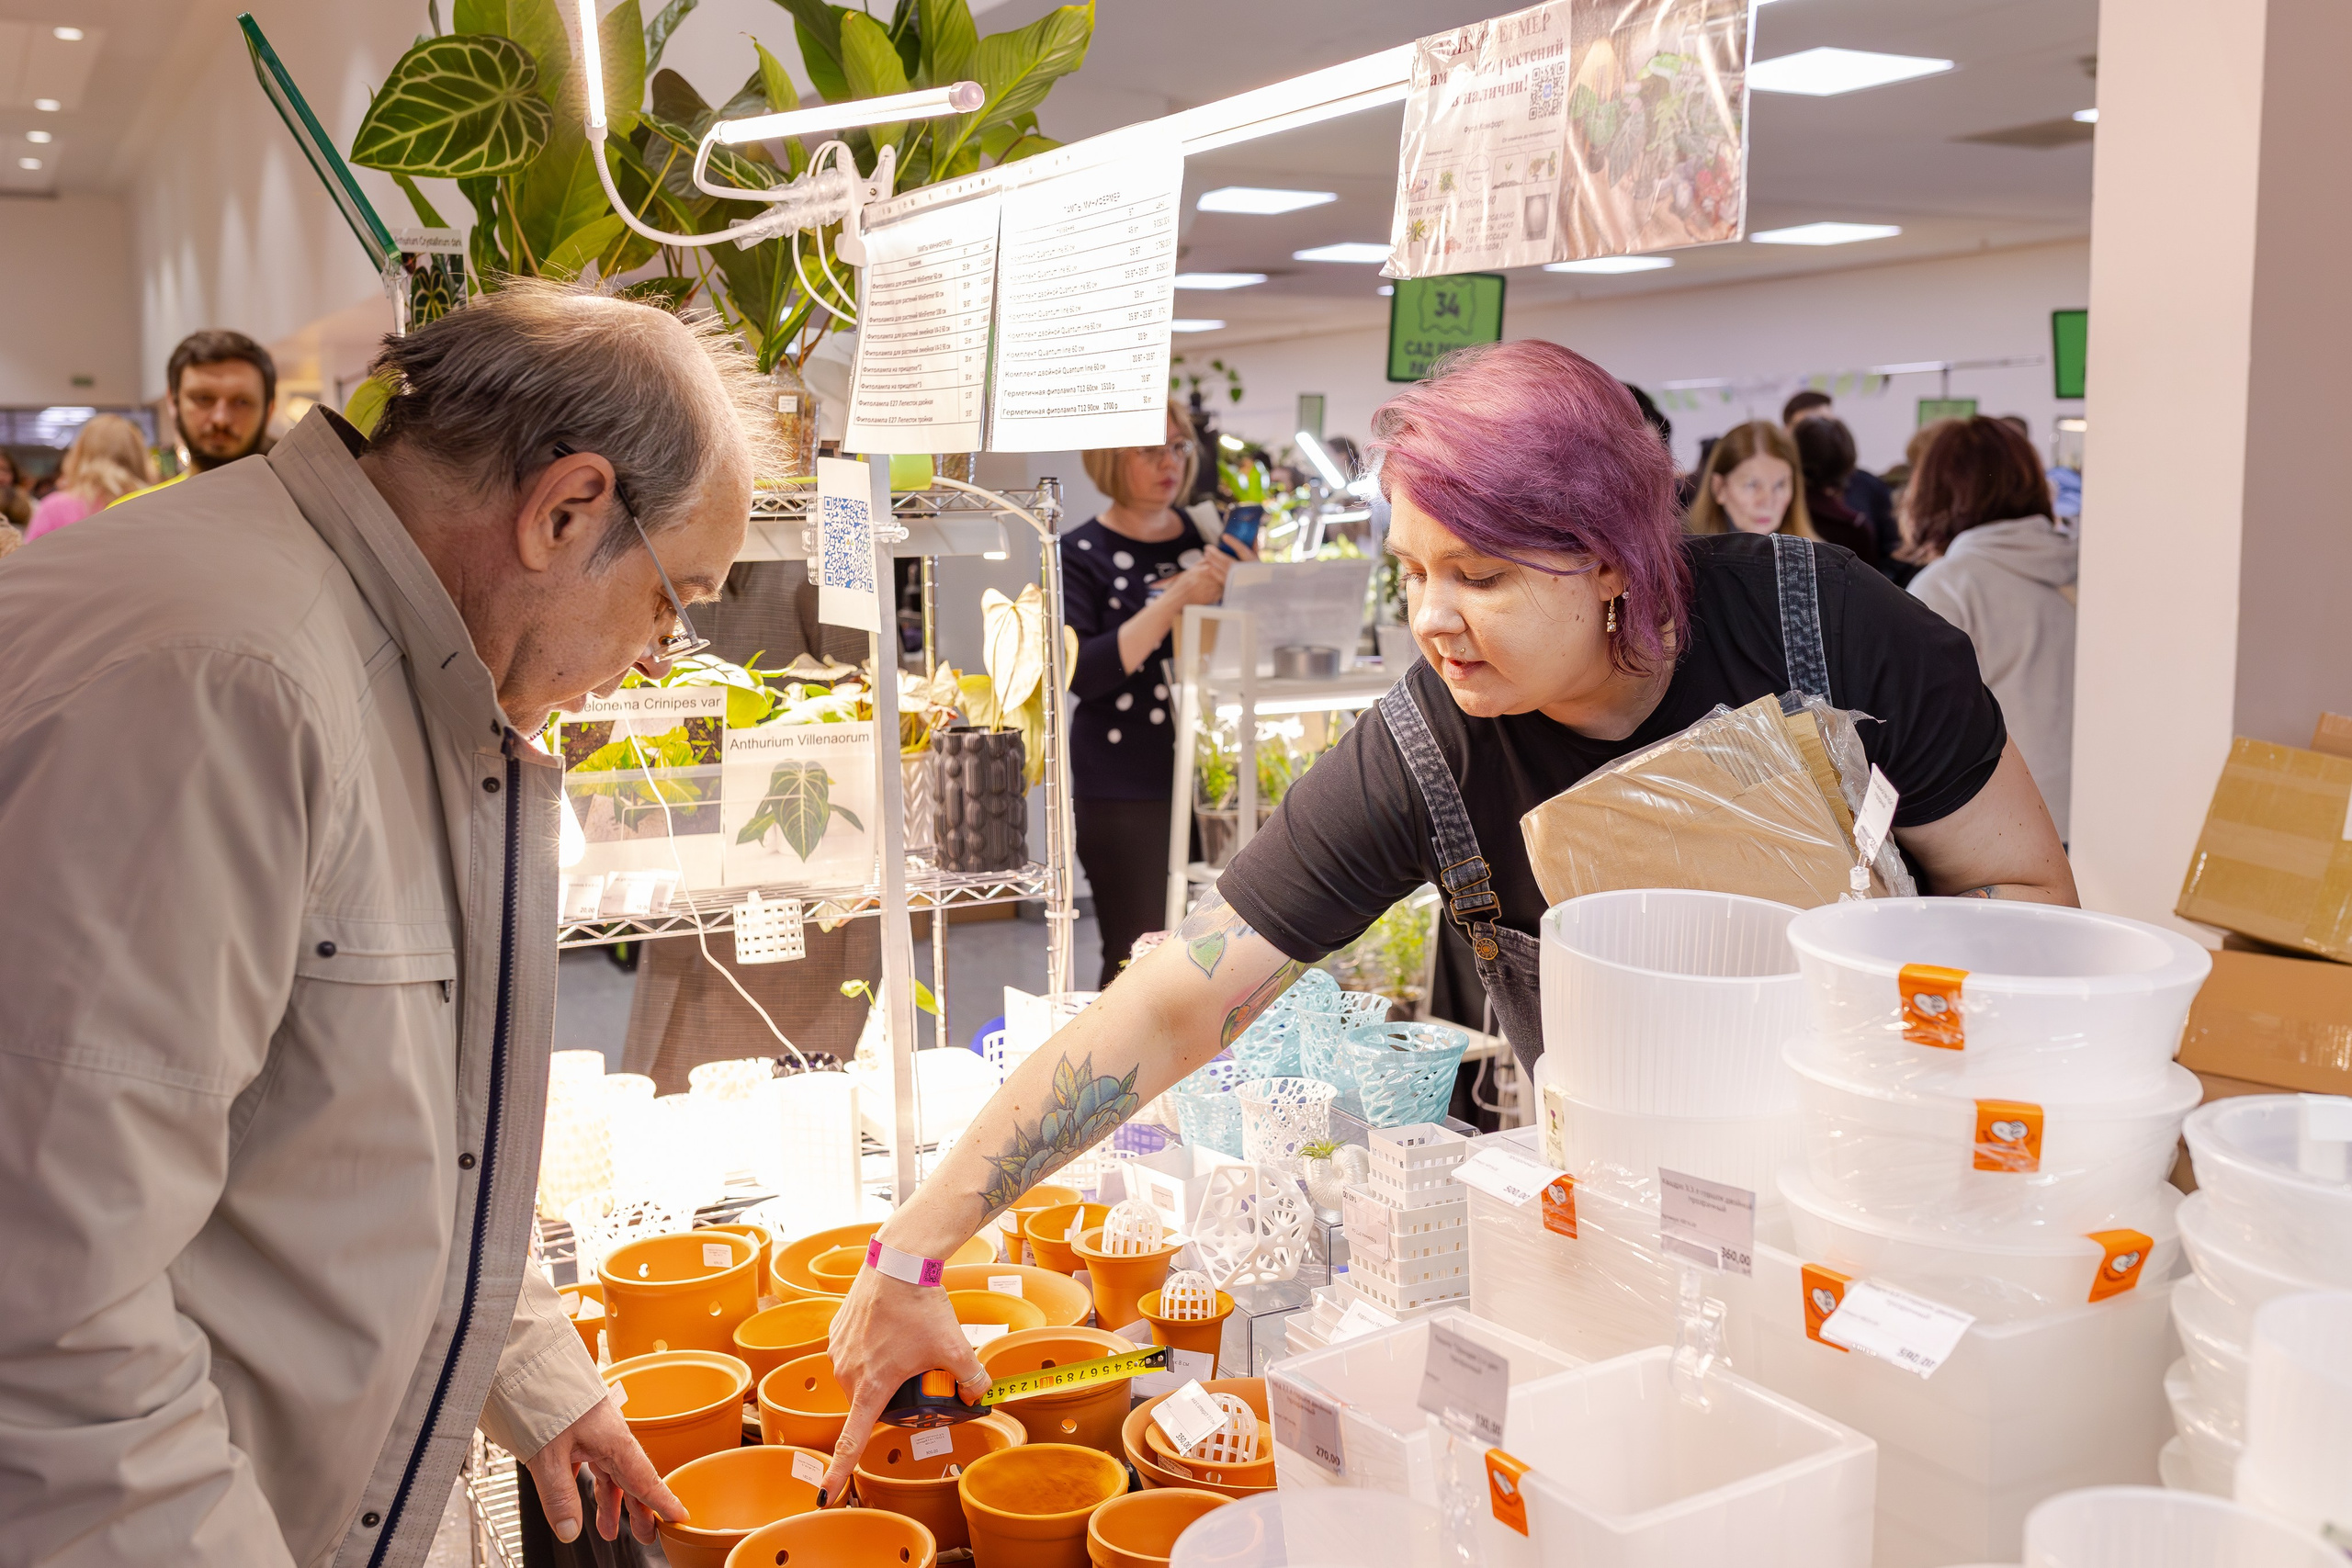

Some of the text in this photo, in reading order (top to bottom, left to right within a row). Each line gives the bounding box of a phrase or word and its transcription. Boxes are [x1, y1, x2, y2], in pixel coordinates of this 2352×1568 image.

[1464, 73, 1528, 106] наличии!
[1434, 290, 1461, 318] 34
[1006, 350, 1037, 358] Комплект
[1037, 348, 1061, 356] Quantum
[1004, 370, 1036, 378] Комплект
[1037, 367, 1062, 378] двойной
[1062, 366, 1084, 375] Quantum
[1003, 389, 1046, 398] Герметичная
[1046, 387, 1077, 397] фитолампа
[1101, 382, 1112, 390] 1510
[1002, 408, 1046, 418] Герметичная
[1046, 405, 1077, 416] фитолампа
[1086, 403, 1100, 412] 90см
[1103, 402, 1115, 411] 2700
[644, 697, 696, 712] Crinipes
[701, 697, 721, 709] var
[729, 732, 870, 751] Anthurium Villenaorum
[1720, 1246, 1752, 1267] 360,00
[1102, 1365, 1110, 1375] 5
[1114, 1363, 1122, 1372] 4
[1126, 1360, 1134, 1370] 3
[1067, 1372, 1074, 1382] 8
[1079, 1370, 1086, 1380] 7
[1091, 1368, 1098, 1377] 6
[1056, 1374, 1062, 1384] 9
[1009, 1384, 1016, 1393] 3
[1021, 1382, 1028, 1392] 2
[1034, 1380, 1039, 1389] 1
[987, 1389, 994, 1399] 5
[998, 1386, 1005, 1396] 4
[1175, 1432, 1193, 1450] 350,00
[1316, 1445, 1340, 1467] 270,00
